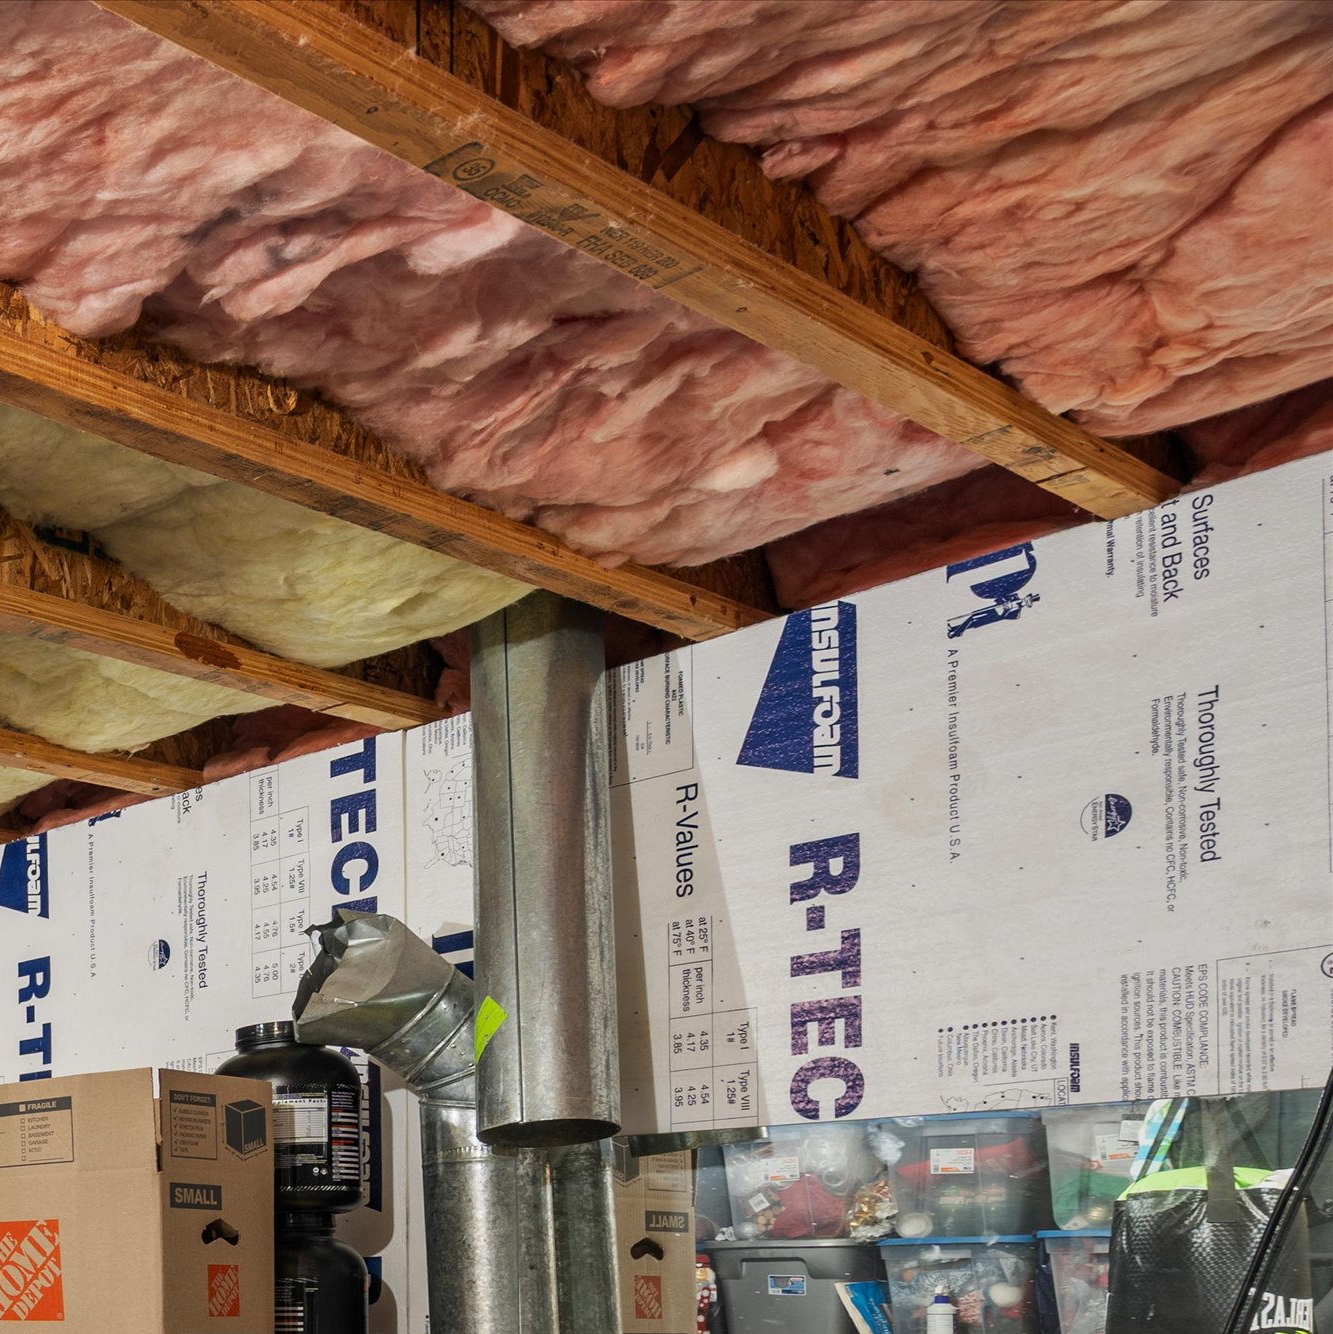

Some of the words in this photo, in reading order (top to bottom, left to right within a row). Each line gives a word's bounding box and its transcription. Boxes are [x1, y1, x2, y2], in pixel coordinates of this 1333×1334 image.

[1160, 512, 1182, 550] and
[1191, 493, 1214, 581] Surfaces
[1161, 552, 1184, 603] Back
[947, 649, 958, 658] A
[948, 660, 959, 708] Premier
[948, 710, 959, 771] Insulfoam
[1192, 684, 1221, 793] Thoroughly
[949, 774, 961, 823] Product
[675, 782, 699, 898] R-Values
[1199, 797, 1222, 863] Tested
[194, 870, 208, 944] Thoroughly
[197, 945, 209, 989] Tested
[789, 832, 865, 1121] R-TEC
[682, 969, 692, 1013] thickness
[695, 984, 704, 1005] inch
[673, 1033, 683, 1055] 3.85
[686, 1031, 696, 1052] 4.17
[699, 1030, 709, 1051] 4.35
[739, 1020, 750, 1042] Type
[674, 1087, 684, 1108] 3.95
[687, 1086, 697, 1106] 4.25
[700, 1084, 710, 1105] 4.54
[740, 1070, 751, 1091] Type
[26, 1100, 57, 1111] FRAGILE
[174, 1186, 219, 1206] SMALL
[11, 1256, 62, 1321] DEPOT
